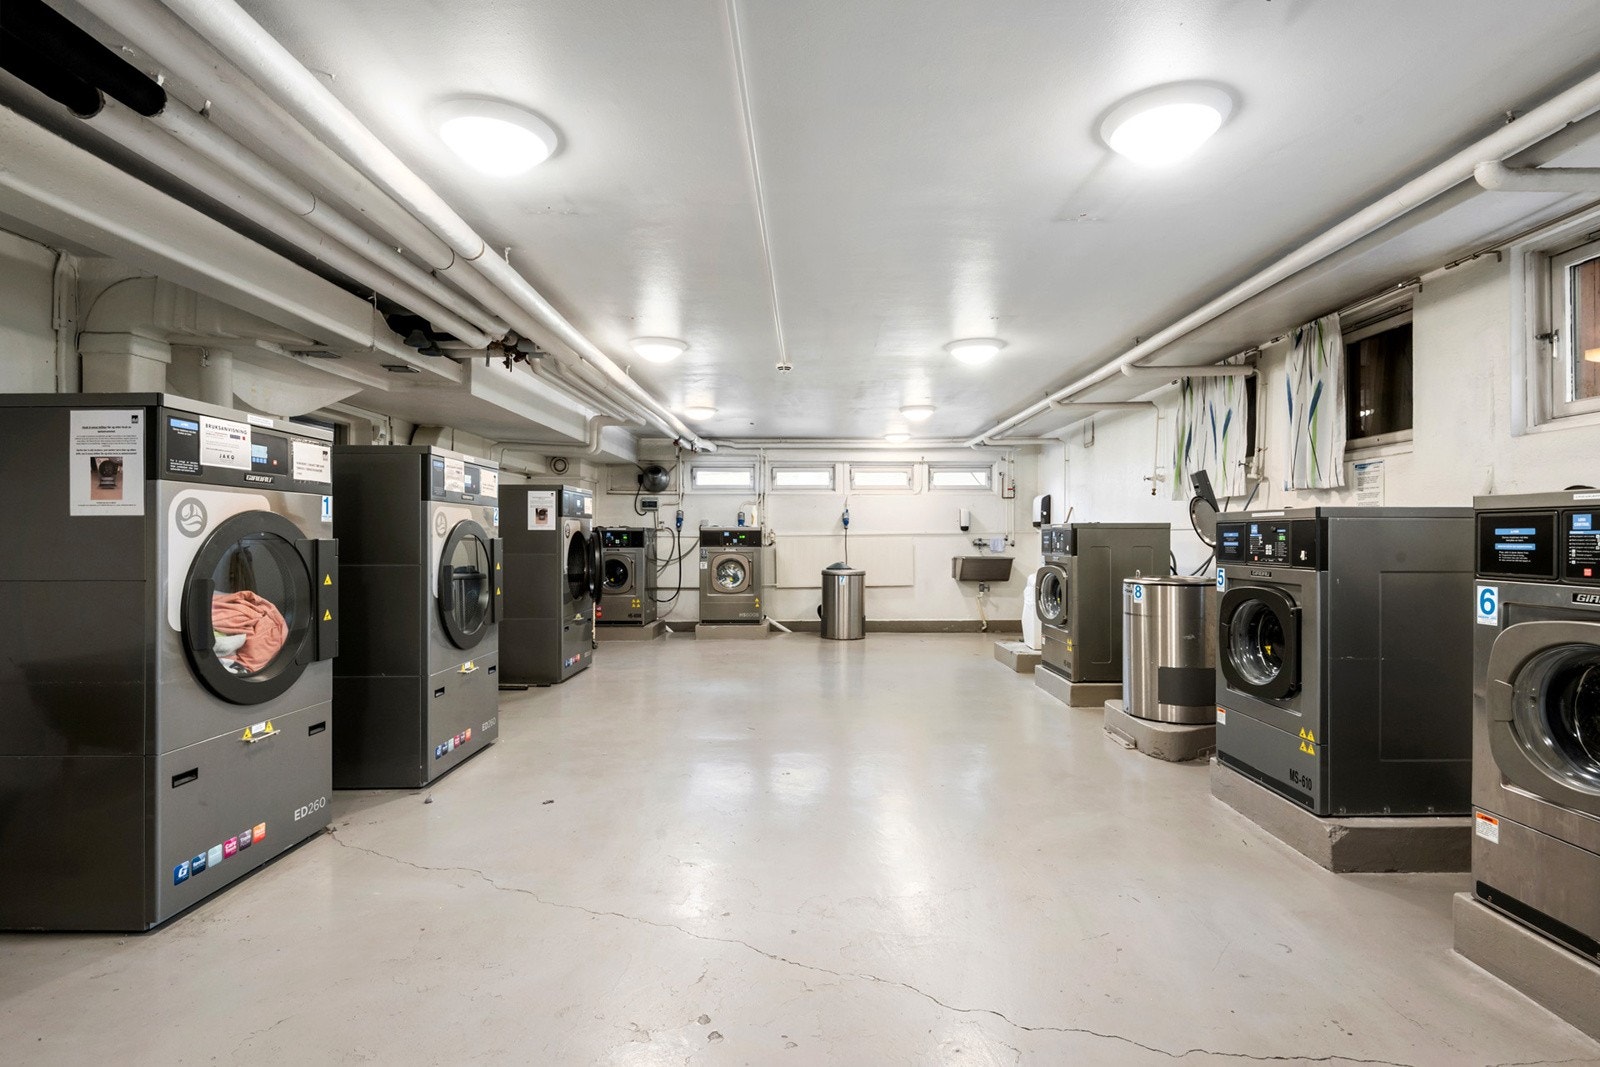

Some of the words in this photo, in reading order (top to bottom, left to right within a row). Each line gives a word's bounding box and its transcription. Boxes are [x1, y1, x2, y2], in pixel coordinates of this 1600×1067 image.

[205, 423, 247, 435] BRUKSANVISNING
[323, 497, 329, 515] 1
[1217, 569, 1224, 586] 5
[1135, 585, 1142, 598] 8
[1479, 588, 1496, 616] 6
[1289, 768, 1312, 791] MS-610
[294, 796, 326, 821] ED260
[178, 865, 188, 878] G
